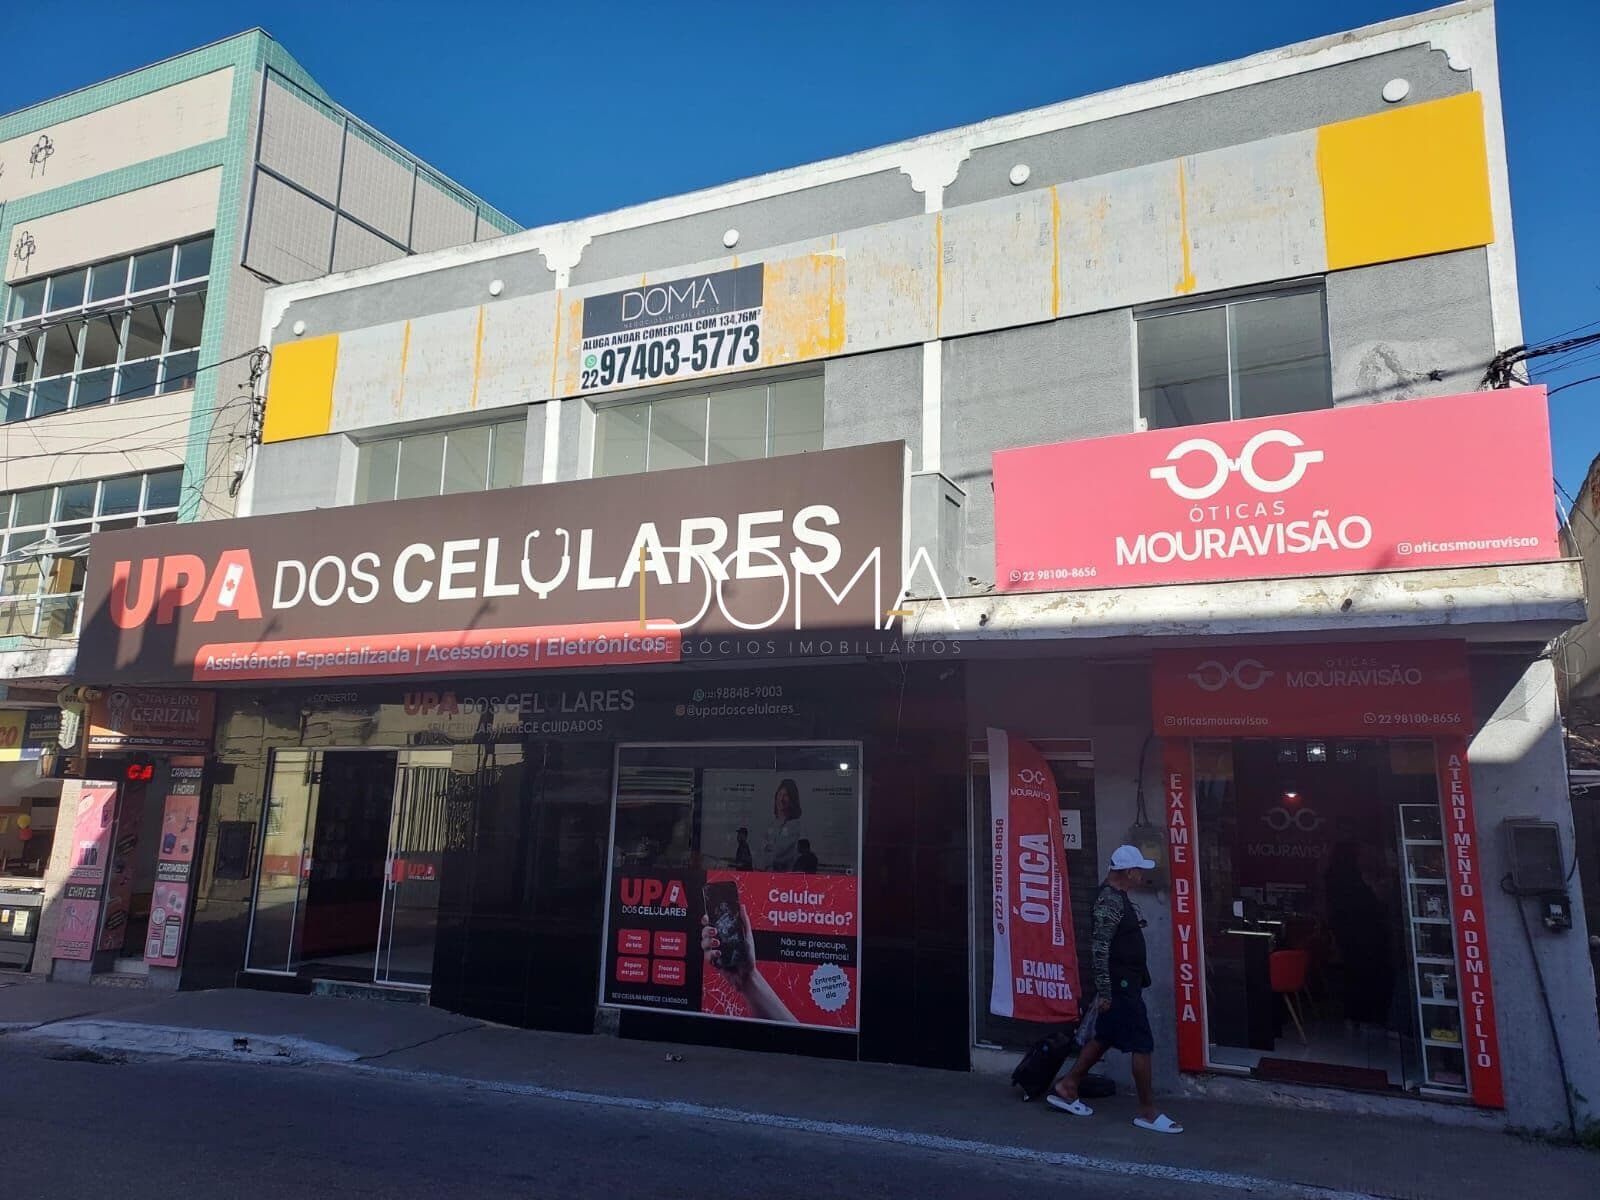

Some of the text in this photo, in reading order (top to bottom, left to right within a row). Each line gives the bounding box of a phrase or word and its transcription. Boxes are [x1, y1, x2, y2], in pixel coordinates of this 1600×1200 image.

[622, 278, 720, 321] DOMA
[583, 337, 609, 350] ALUGA
[612, 331, 641, 344] ANDAR
[643, 324, 693, 339] COMERCIAL
[696, 319, 717, 331] COM
[581, 324, 760, 390] 22 97403-5773
[1190, 500, 1286, 523] ÓTICAS
[1116, 510, 1372, 566] MOURAVISÃO
[110, 504, 843, 629] UPA DOS CELULARES
[1022, 565, 1098, 582] 22 98100-8656
[204, 648, 292, 672] Assistência
[295, 643, 411, 670] Especializada
[425, 637, 530, 662] Acessórios
[545, 633, 666, 660] Eletrônicos
[1286, 664, 1423, 689] MOURAVISÃO
[403, 691, 458, 716] UPA
[463, 696, 498, 715] DOS
[542, 719, 603, 733] CUIDADOS
[1378, 712, 1462, 724] 22 98100-8656
[1013, 833, 1050, 923] ÓTICA
[68, 886, 97, 898] CHAVES
[620, 877, 688, 908] UPA
[768, 888, 825, 906] Celular
[1170, 773, 1197, 1022] EXAME DE VISTA
[767, 907, 853, 928] quebrado?
[1448, 754, 1491, 1068] ATENDIMENTO A DOMICÍLIO
[779, 936, 797, 947] Não
[798, 939, 807, 947] se
[779, 948, 794, 958] nós
[814, 973, 842, 986] Entrega
[1022, 959, 1065, 981] EXAME
[822, 980, 848, 993] mesmo
[825, 990, 837, 999] dia
[1015, 977, 1073, 1000] DE VISTA
